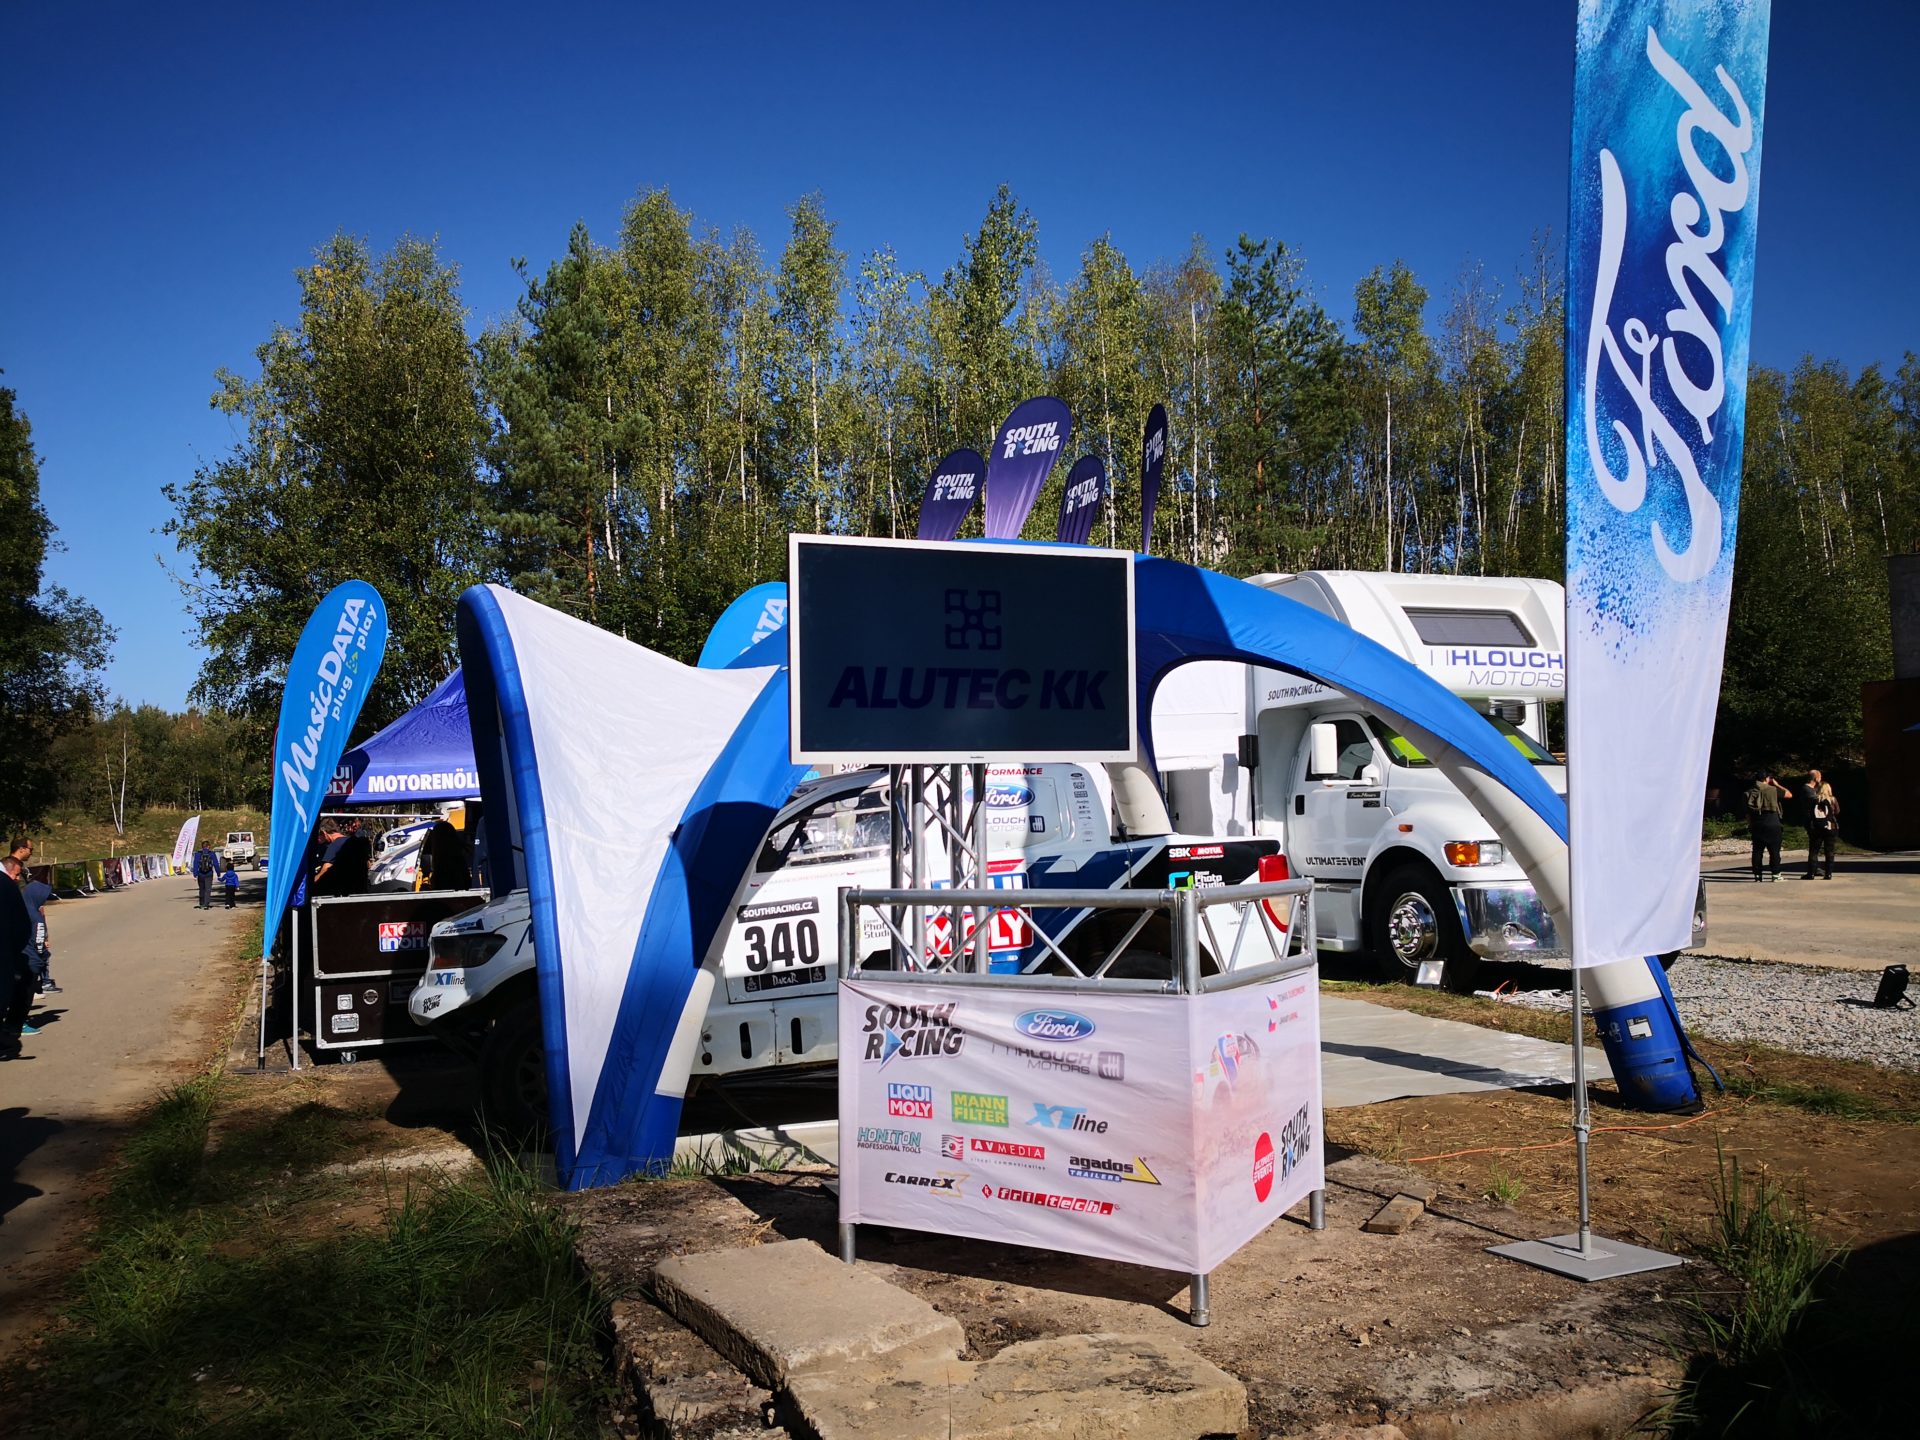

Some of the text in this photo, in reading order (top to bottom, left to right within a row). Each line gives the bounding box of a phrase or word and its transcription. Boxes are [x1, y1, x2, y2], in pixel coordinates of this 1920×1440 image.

[1586, 26, 1752, 582] Ford
[1003, 421, 1058, 445] SOUTH
[934, 473, 975, 489] SOUTH
[1067, 477, 1097, 500] SOUTH
[331, 675, 353, 721] plug
[356, 603, 377, 650] play
[1451, 650, 1564, 669] HLOUCH
[1468, 670, 1565, 688] MOTORS
[827, 666, 1110, 711] ALUTEC KK
[282, 599, 365, 833] MusicDATA
[1169, 847, 1191, 858] SBK
[742, 901, 813, 918] SOUTHRACING.CZ
[744, 918, 820, 973] 340
[434, 973, 466, 986] XTline
[862, 1002, 956, 1032] SOUTH
[1028, 1012, 1080, 1037] Ford
[1027, 1059, 1090, 1075] MOTORS
[889, 1084, 931, 1102] LIQUI
[954, 1093, 1006, 1110] MANN
[890, 1100, 932, 1118] MOLY
[954, 1108, 1007, 1124] FILTER
[1025, 1103, 1109, 1134] XTline
[857, 1127, 922, 1146] HONITON
[1281, 1101, 1308, 1155] SOUTH
[857, 1142, 921, 1154] PROFESSIONAL TOOLS
[1069, 1156, 1134, 1173] agados
[1070, 1169, 1121, 1182] TRAILERS
